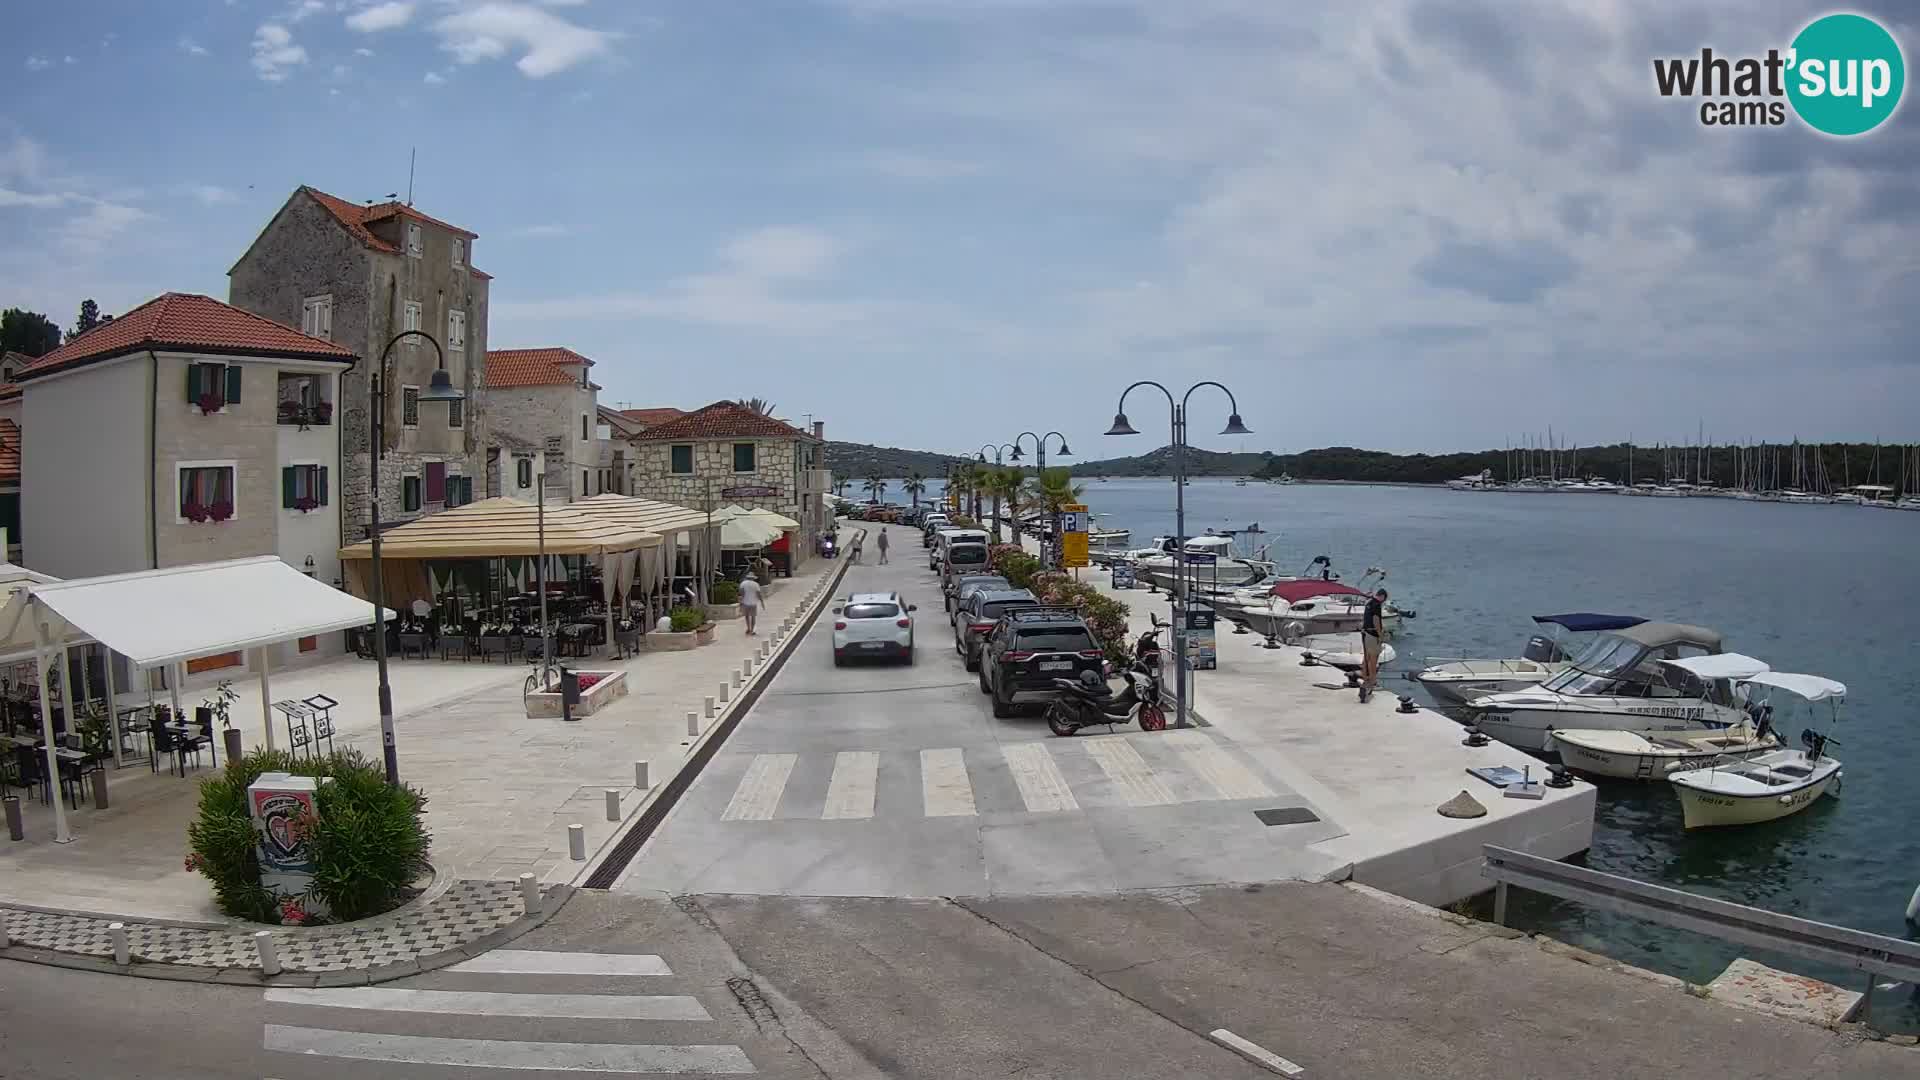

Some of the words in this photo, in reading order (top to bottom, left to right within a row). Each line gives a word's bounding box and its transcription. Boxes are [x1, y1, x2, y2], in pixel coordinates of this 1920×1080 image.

[1065, 514, 1075, 530] P
[1661, 707, 1681, 717] RENT
[1681, 708, 1687, 718] A
